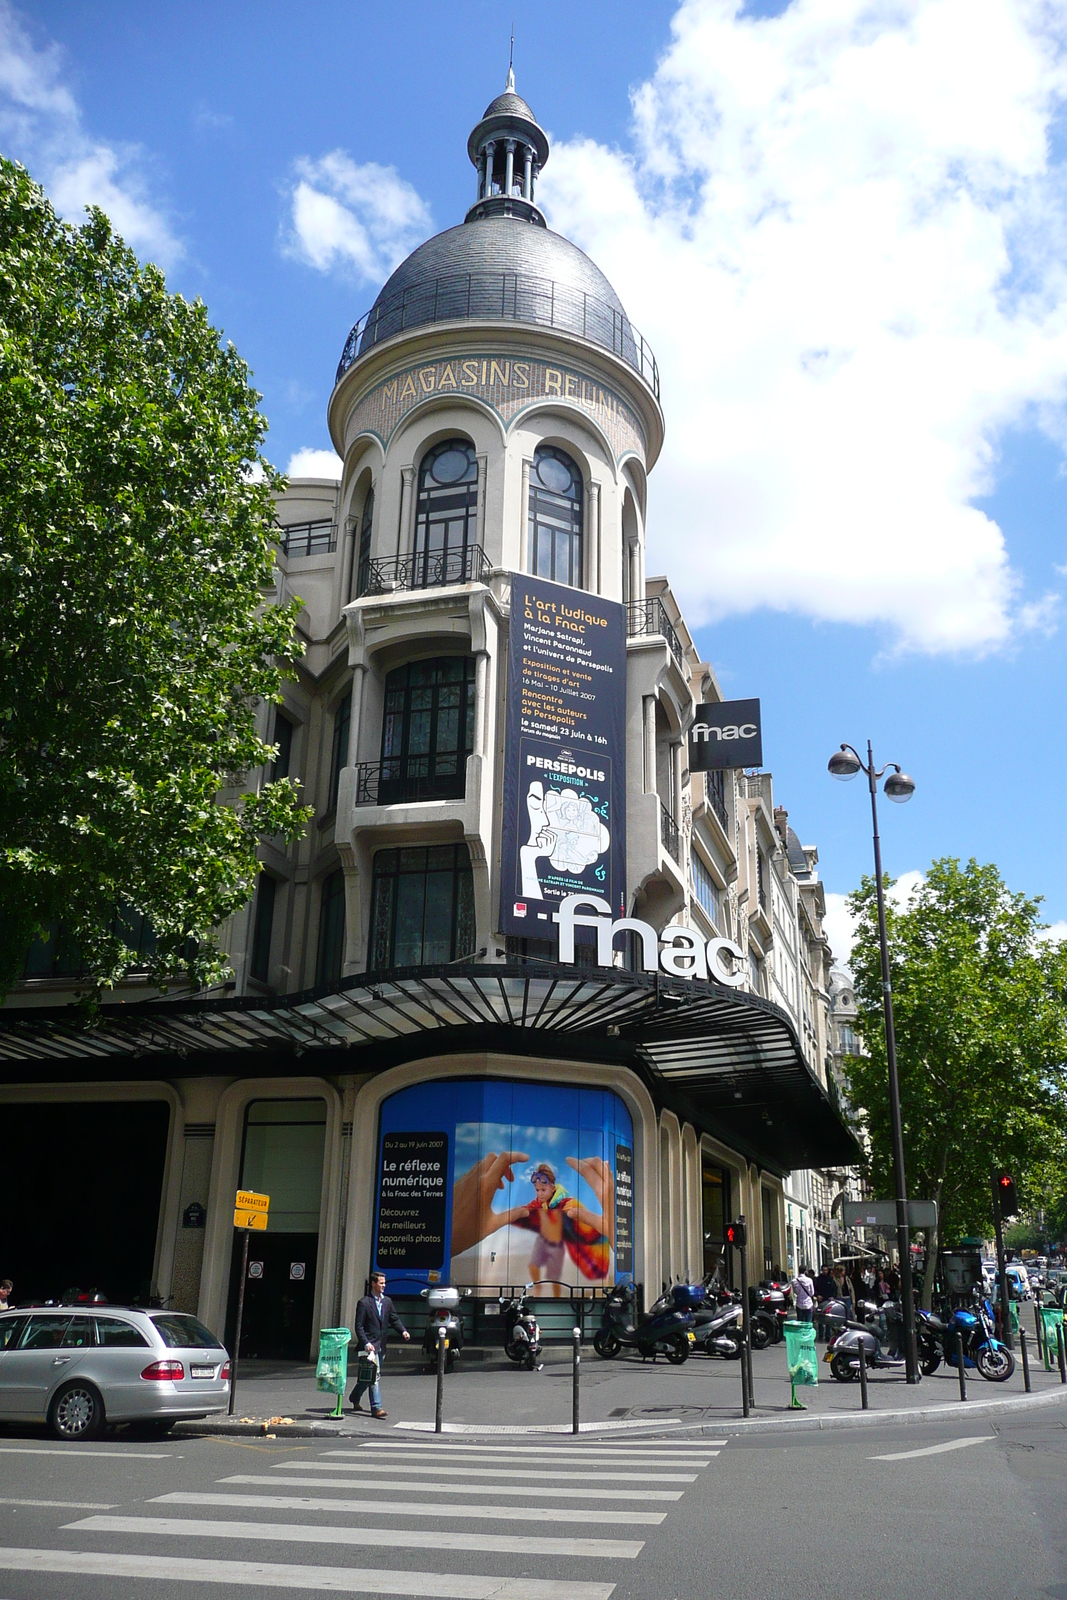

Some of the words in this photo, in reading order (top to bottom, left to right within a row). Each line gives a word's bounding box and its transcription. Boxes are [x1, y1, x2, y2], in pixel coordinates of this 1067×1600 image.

[381, 360, 530, 410] MAGASINS
[544, 368, 628, 434] REUNIS
[524, 594, 557, 613] L'art
[561, 604, 608, 627] ludique
[524, 607, 534, 620] à
[537, 610, 551, 624] la
[555, 615, 586, 634] Fnac
[523, 622, 555, 637] Marjane
[556, 631, 586, 646] Satrapi,
[523, 632, 552, 646] Vincent
[552, 640, 592, 657] Paronnaud
[523, 644, 532, 652] et
[533, 644, 564, 660] l'univers
[565, 654, 576, 663] de
[576, 657, 614, 673] Persepolis
[522, 657, 561, 673] Exposition
[562, 667, 571, 676] et
[571, 671, 593, 682] vente
[522, 667, 532, 676] de
[533, 670, 561, 684] tirages
[561, 676, 580, 688] d'art
[522, 677, 531, 685] 16
[550, 683, 559, 692] 10
[559, 685, 579, 697] Juillet
[580, 691, 597, 701] 2007
[522, 688, 564, 705] Rencontre
[521, 698, 542, 709] avec
[543, 702, 555, 712] les
[556, 707, 588, 720] auteurs
[521, 706, 532, 716] de
[534, 709, 576, 726] Persepolis
[530, 720, 558, 733] samedi
[559, 726, 570, 736] 23
[570, 729, 586, 740] juin
[586, 733, 593, 742] à
[593, 735, 608, 746] 16h
[692, 722, 758, 743] fnac
[526, 754, 606, 782] PERSEPOLIS
[548, 772, 585, 787] L'EXPOSITION
[552, 893, 747, 987] fnac
[384, 1141, 394, 1149] Du
[415, 1141, 428, 1149] juin
[428, 1140, 444, 1148] 2007
[383, 1160, 397, 1172] Le
[399, 1159, 441, 1172] réflexe
[382, 1174, 444, 1188] numérique
[238, 1195, 268, 1208] SÉPARATEUR
[381, 1190, 386, 1198] à
[387, 1190, 394, 1198] la
[394, 1190, 410, 1198] Fnac
[410, 1190, 422, 1198] des
[422, 1190, 444, 1198] Ternes
[380, 1208, 420, 1217] Découvrez
[379, 1221, 391, 1229] les
[391, 1220, 426, 1230] meilleurs
[379, 1234, 414, 1244] appareils
[415, 1234, 441, 1244] photos
[378, 1246, 388, 1256] de
[389, 1246, 407, 1256] l'été
